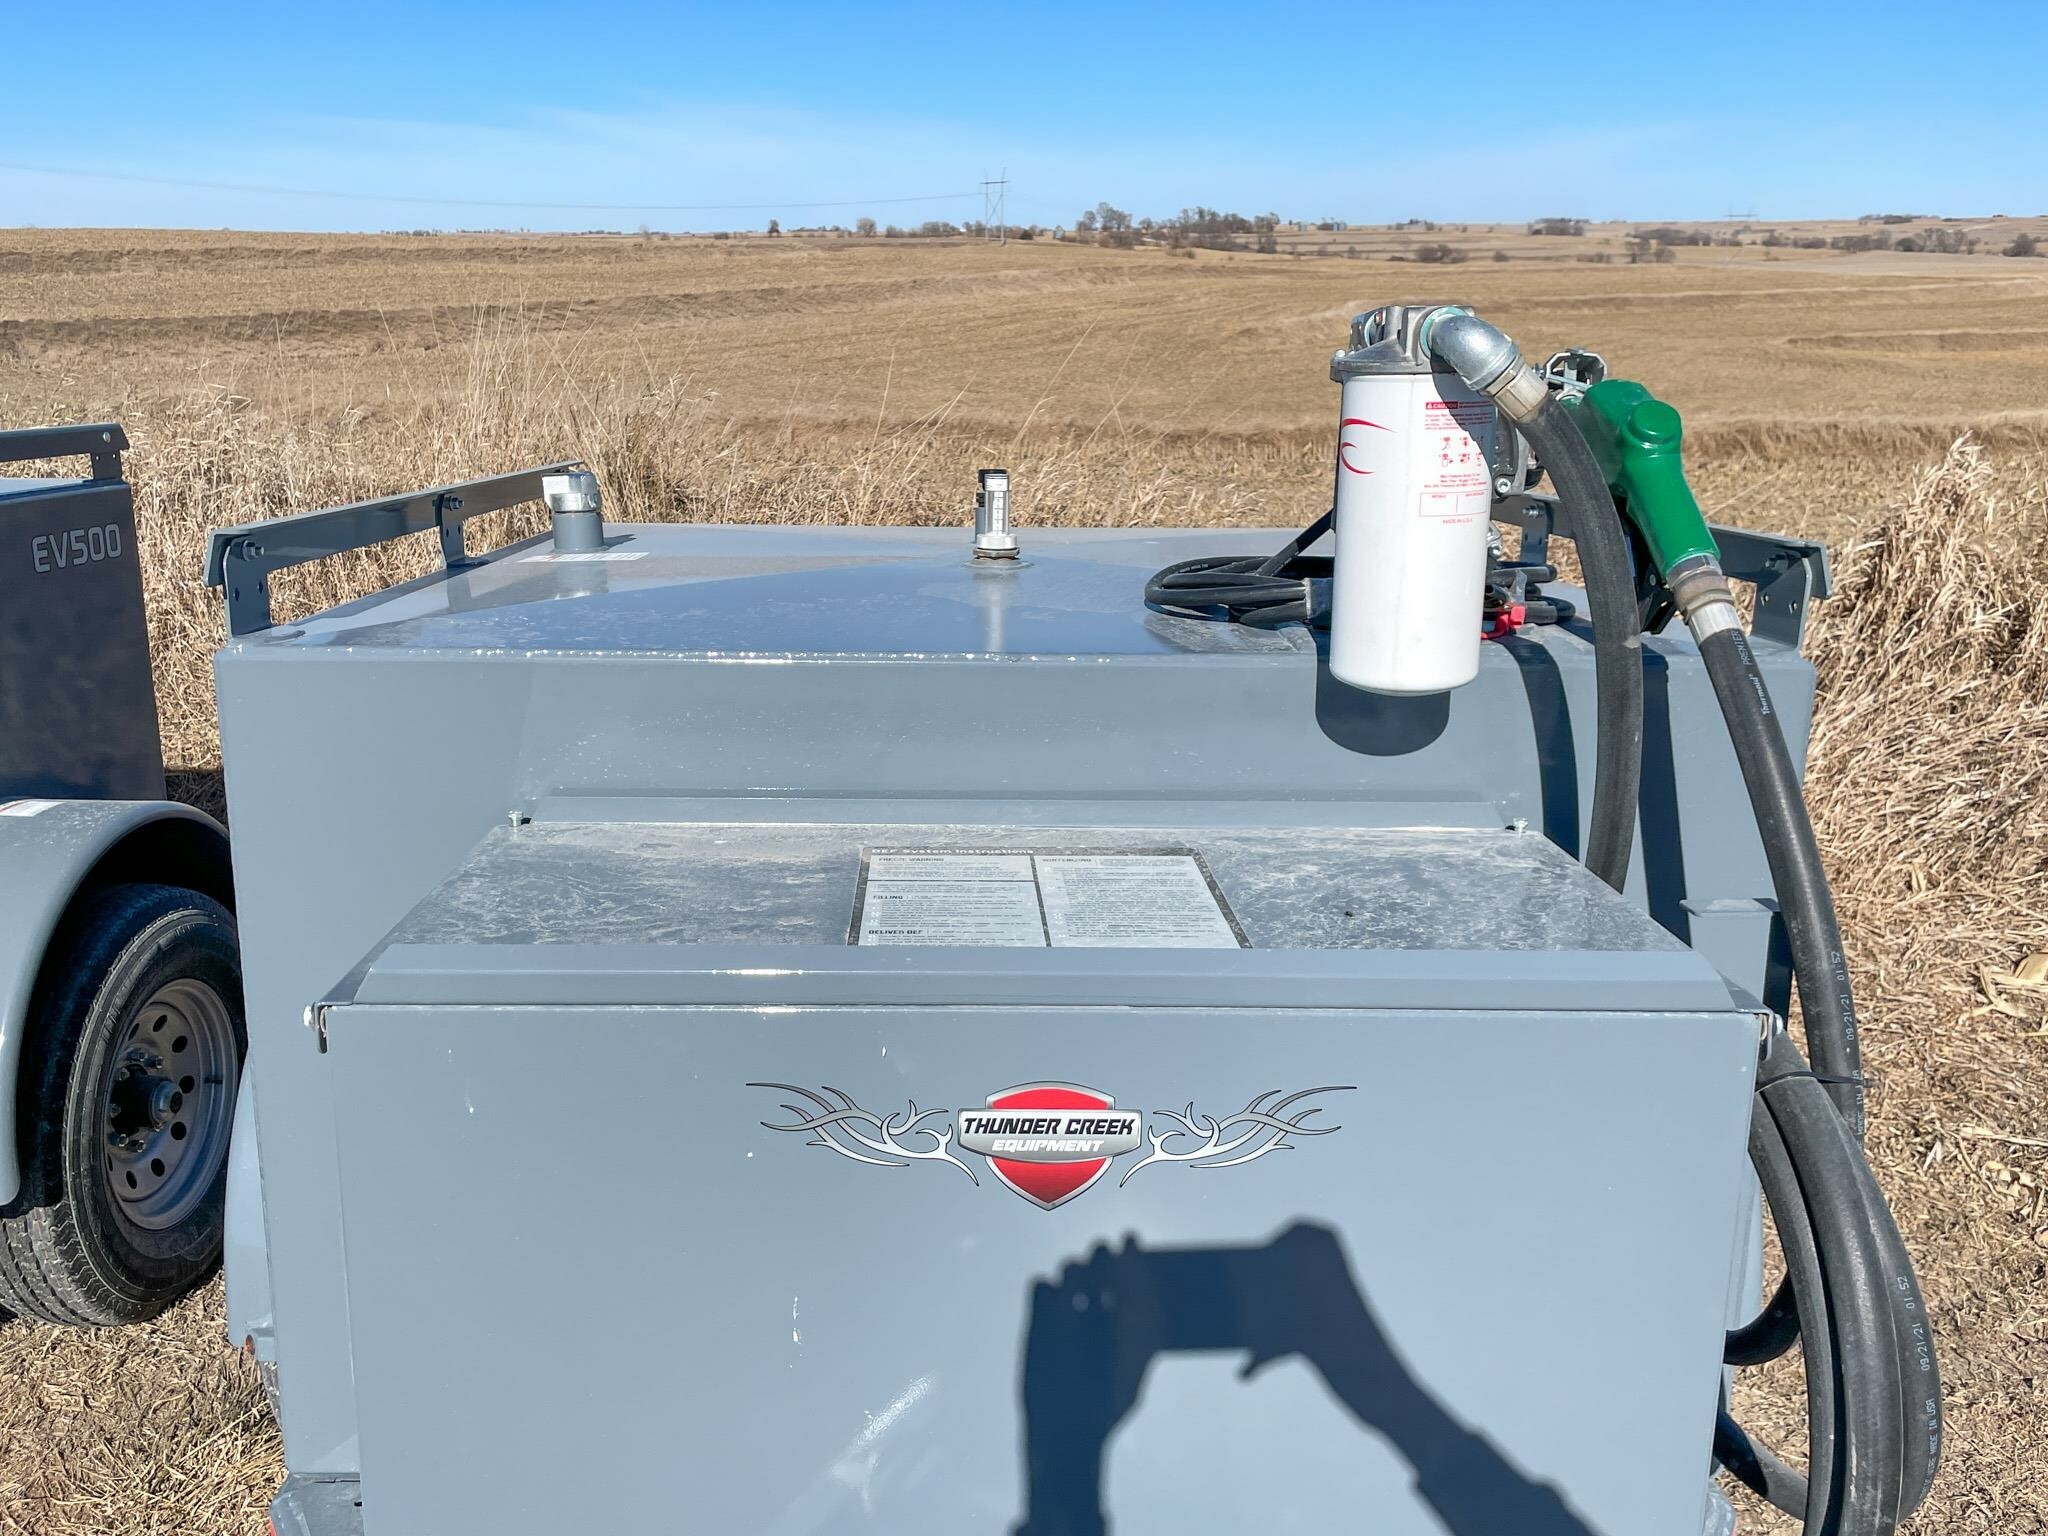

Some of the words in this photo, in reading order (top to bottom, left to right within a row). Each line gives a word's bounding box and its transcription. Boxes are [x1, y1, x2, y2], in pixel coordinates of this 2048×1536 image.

[32, 523, 121, 573] EV500
[903, 848, 952, 856] System
[955, 848, 1034, 856] Instructions
[1840, 994, 1855, 1041] 09/21/21
[964, 1118, 1062, 1135] THUNDER
[1064, 1118, 1136, 1135] CREEK
[991, 1139, 1105, 1153] EQUIPMENT
[1911, 1323, 1931, 1371] 09/21/21
[1925, 1398, 1936, 1417] USA
